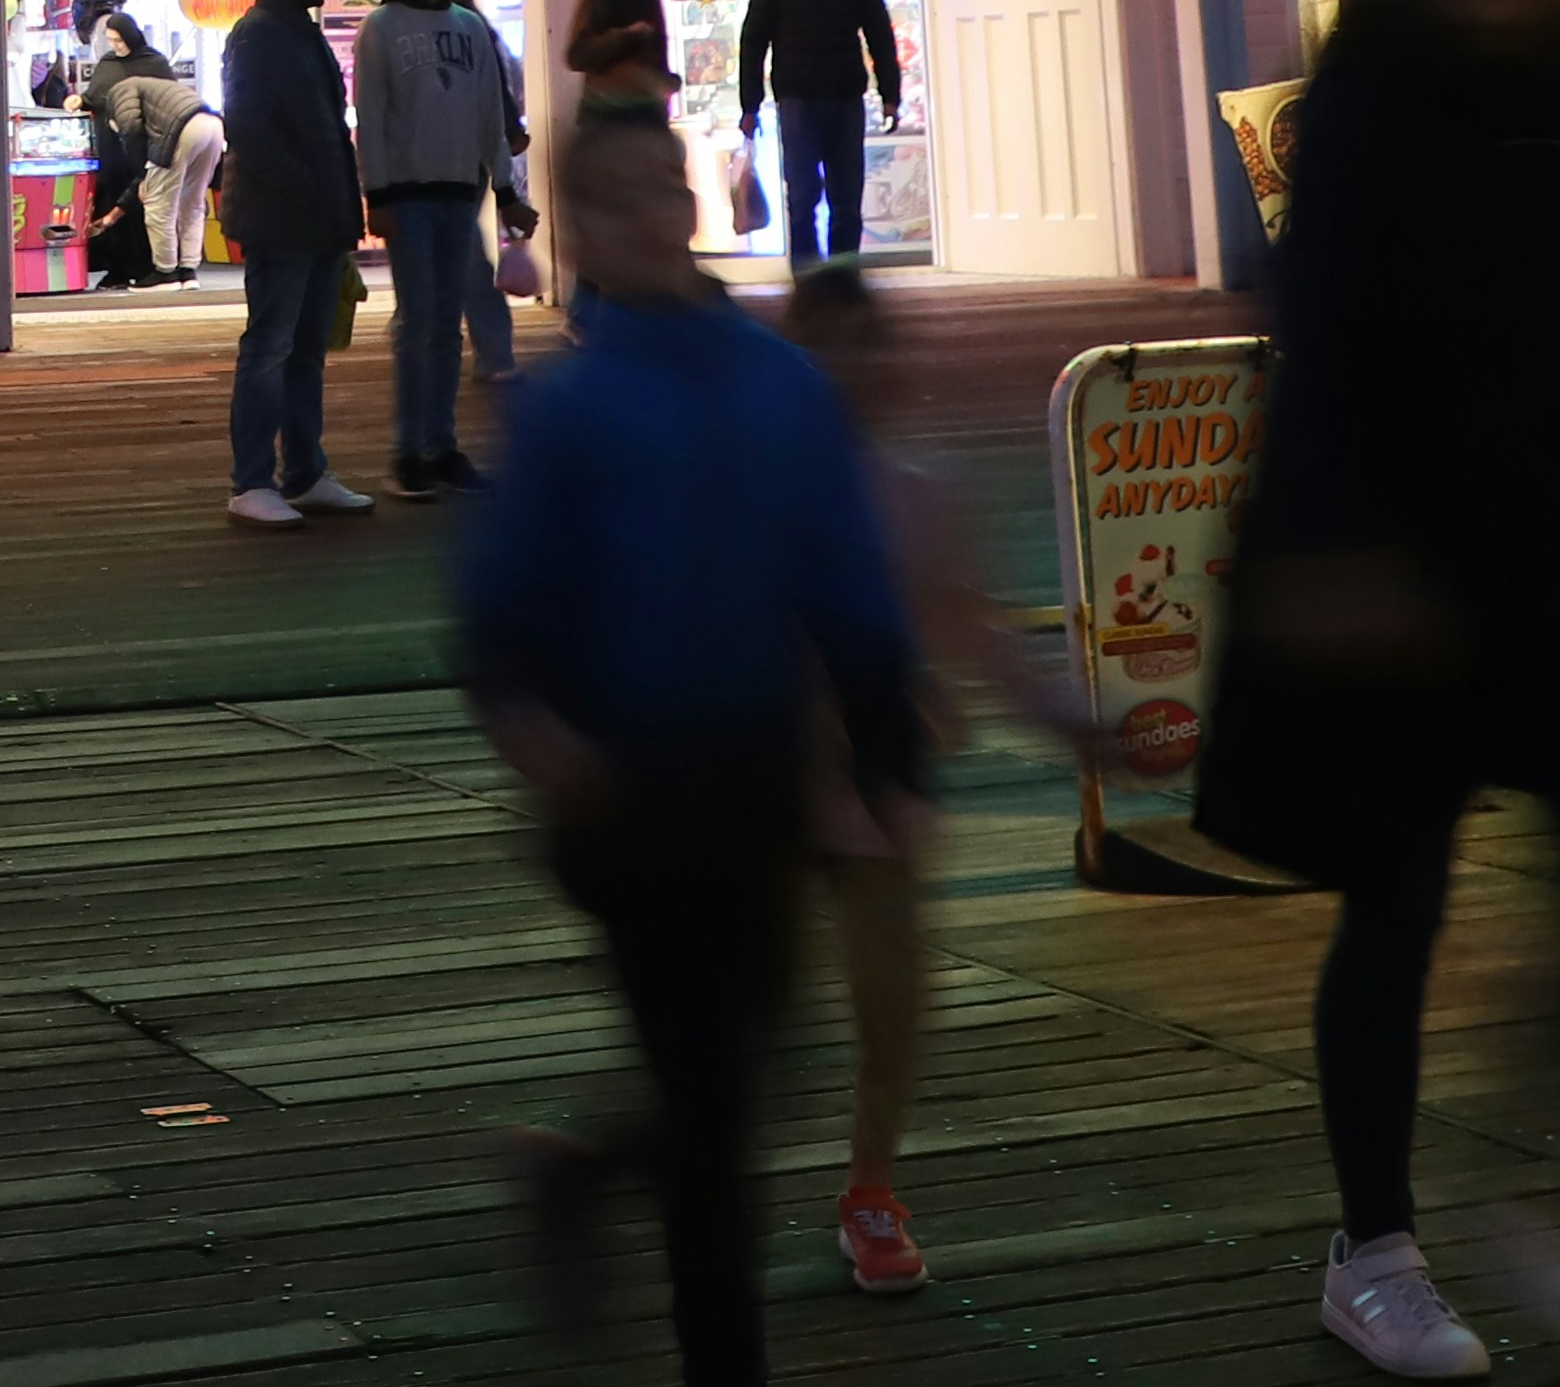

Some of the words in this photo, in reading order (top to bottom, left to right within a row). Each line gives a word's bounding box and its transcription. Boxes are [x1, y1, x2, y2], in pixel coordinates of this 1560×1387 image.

[1127, 374, 1238, 412] ENJOY
[1244, 372, 1266, 402] A
[1088, 410, 1268, 476] SUNDA
